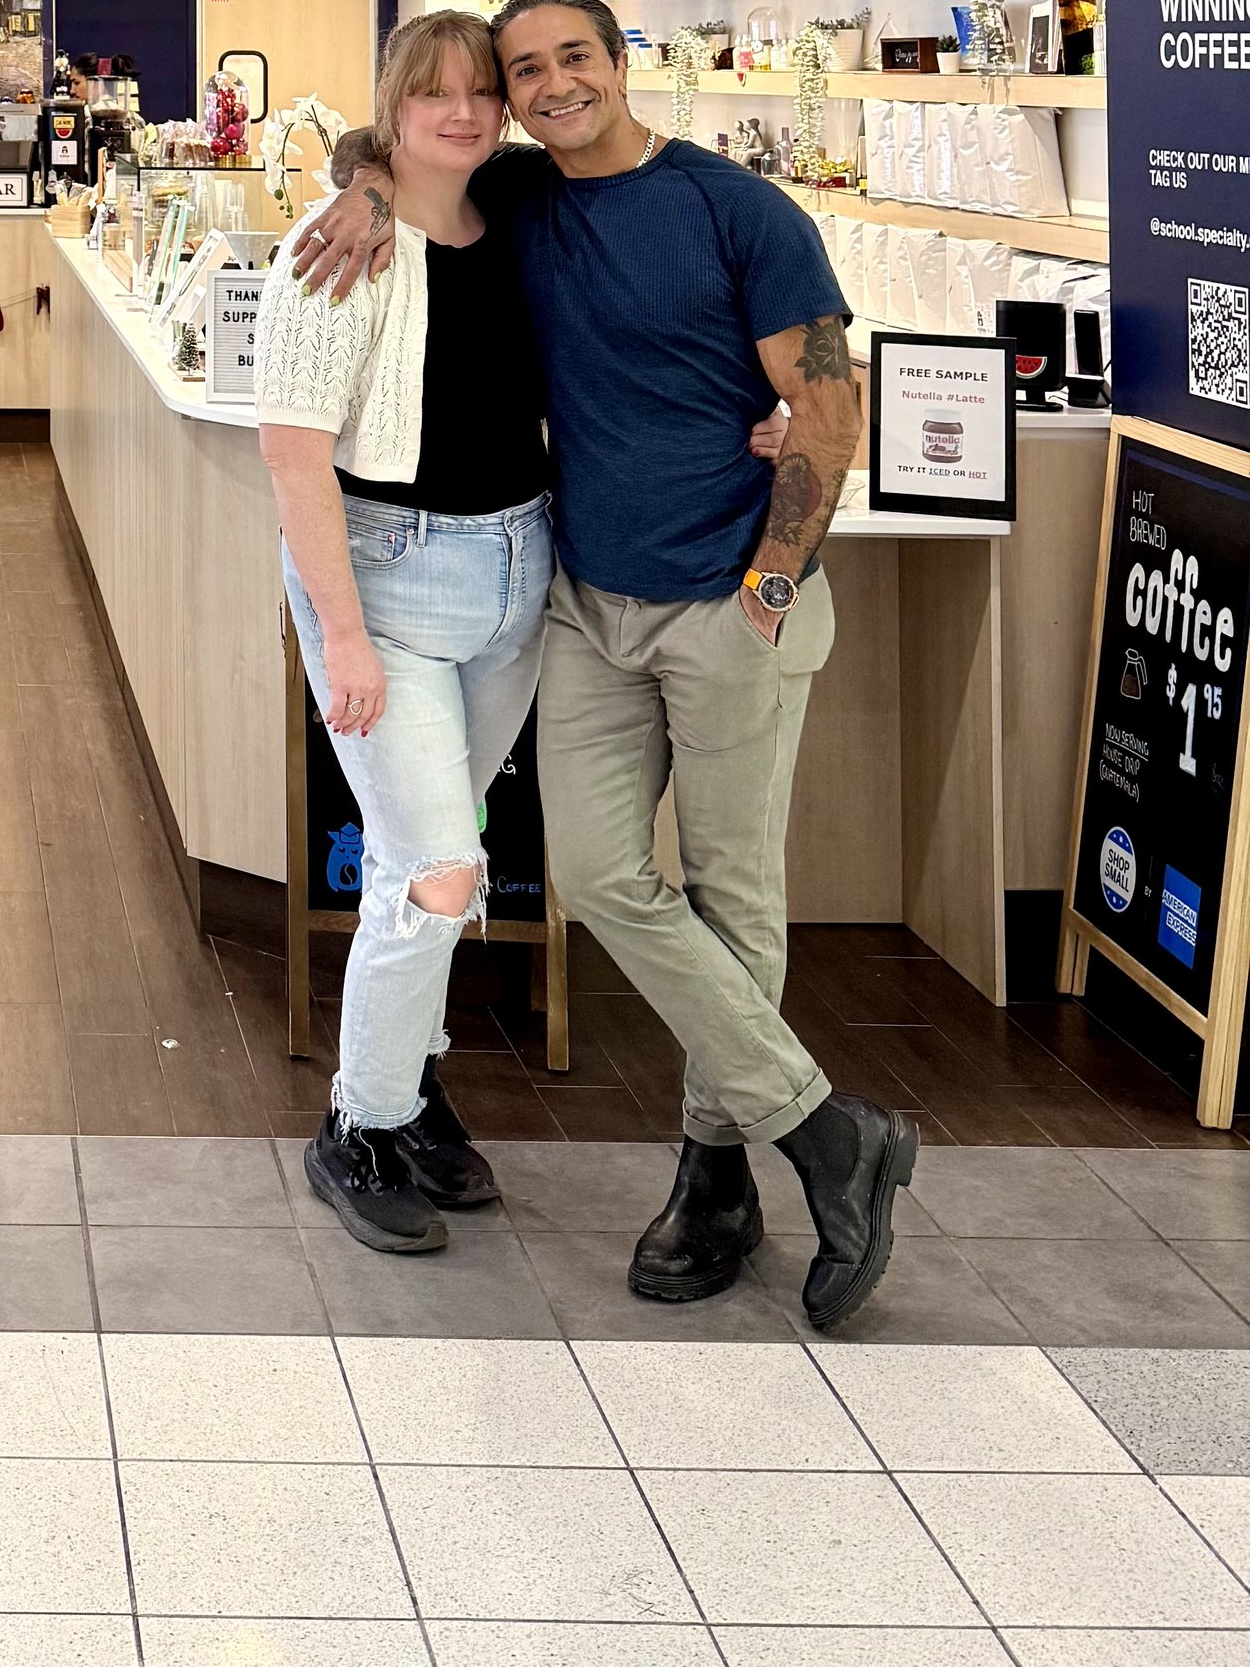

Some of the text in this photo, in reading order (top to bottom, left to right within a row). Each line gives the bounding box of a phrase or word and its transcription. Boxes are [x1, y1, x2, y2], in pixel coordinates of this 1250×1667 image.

[1160, 32, 1250, 69] COFFEE
[1149, 149, 1250, 174] CHECK OUT OUR M
[1150, 170, 1187, 188] TAG US
[1150, 218, 1250, 253] @school.specialty.
[226, 290, 262, 301] THAN
[223, 311, 256, 322] SUPP
[900, 368, 988, 382] FREE SAMPLE
[902, 390, 985, 404] Nutella #Latte
[925, 434, 960, 444] nutella
[929, 468, 950, 476] ICED
[968, 471, 987, 479] HOT
[1132, 490, 1154, 515] HOT
[1130, 516, 1166, 550] BREWED
[1126, 548, 1234, 672] coffee
[1106, 723, 1149, 756] NOW SERVING
[1103, 744, 1140, 775] HOUSE DRIP
[1107, 849, 1130, 874] SHOP
[497, 875, 541, 893] COFFEE
[1104, 862, 1129, 893] SMALL
[1162, 889, 1197, 927] AMERICAN
[1166, 911, 1197, 947] EXPRESS
